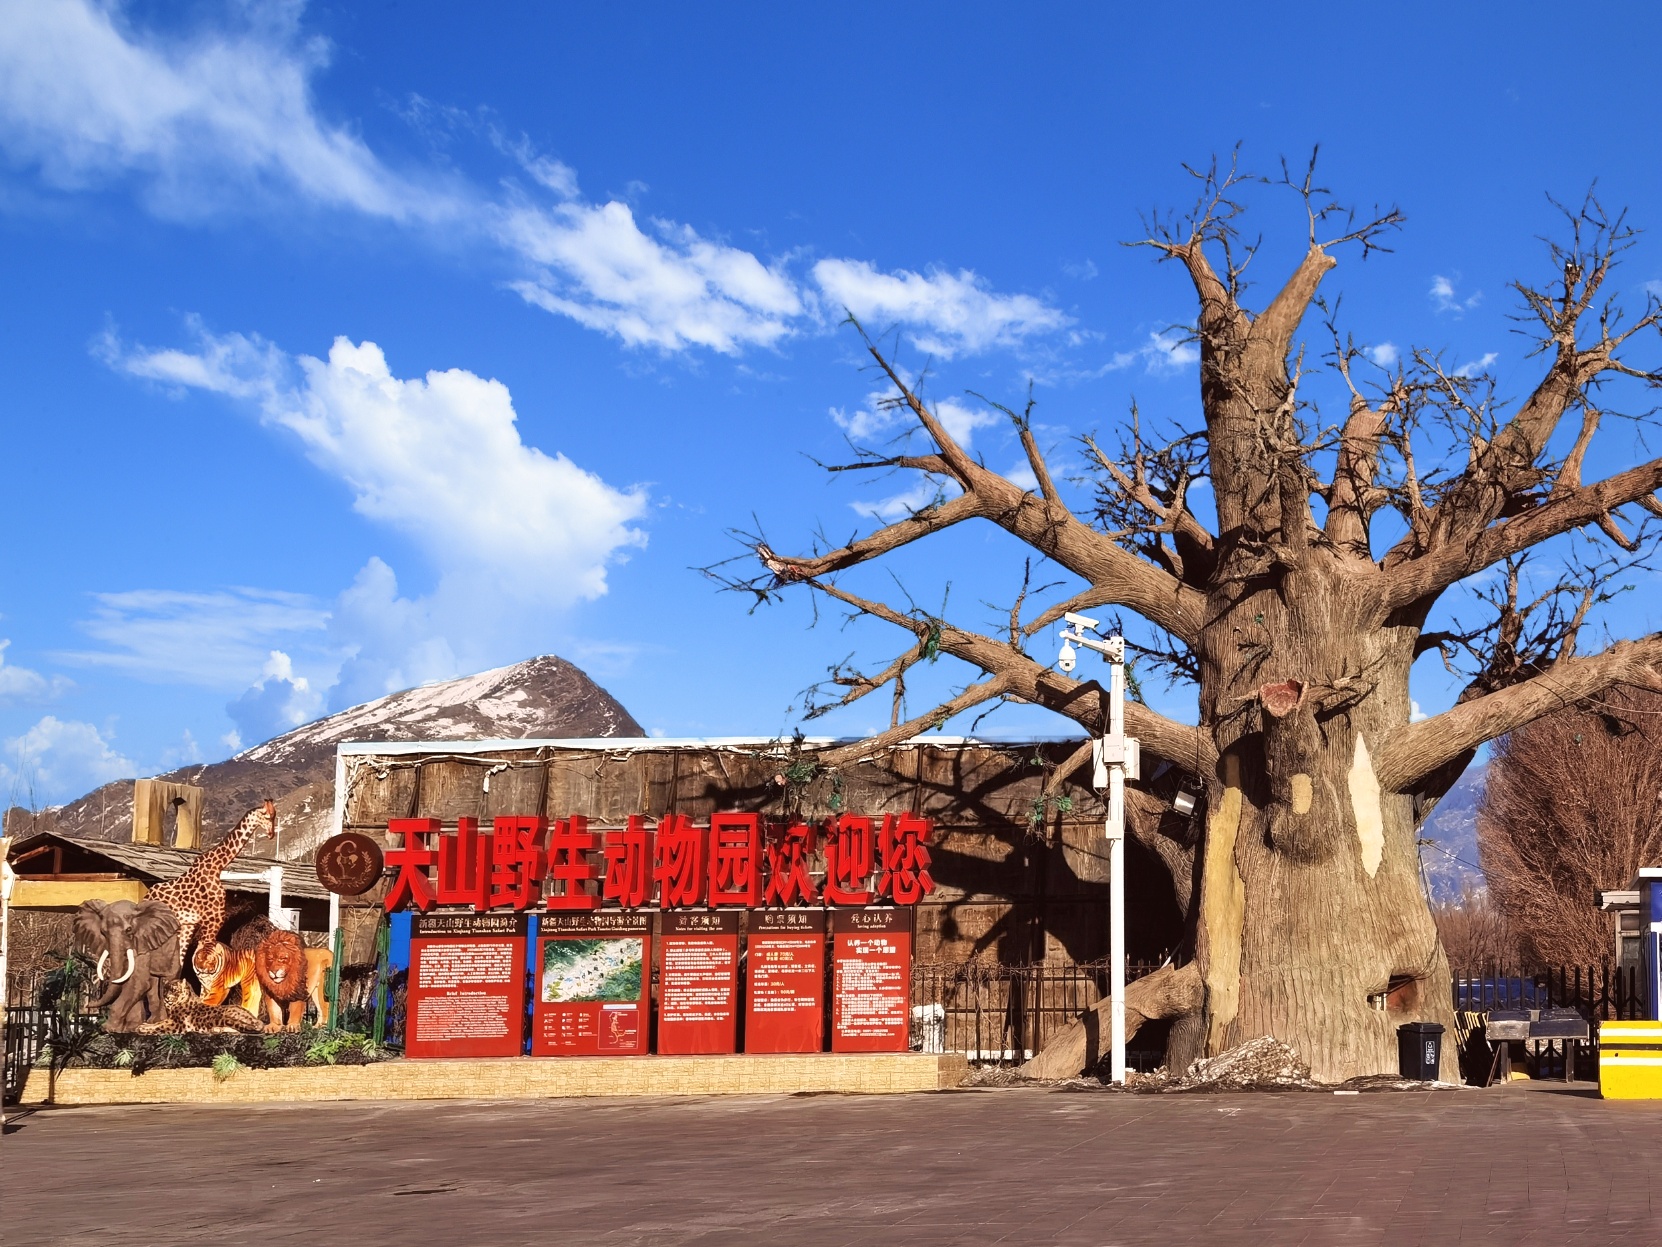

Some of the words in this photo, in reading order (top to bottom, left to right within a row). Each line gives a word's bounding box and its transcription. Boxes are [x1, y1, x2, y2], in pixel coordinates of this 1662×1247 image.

[384, 811, 936, 912] 天山野生动物园欢迎您
[418, 916, 518, 928] 新疆天山野生动物园简介
[851, 913, 893, 923] 爱心认养
